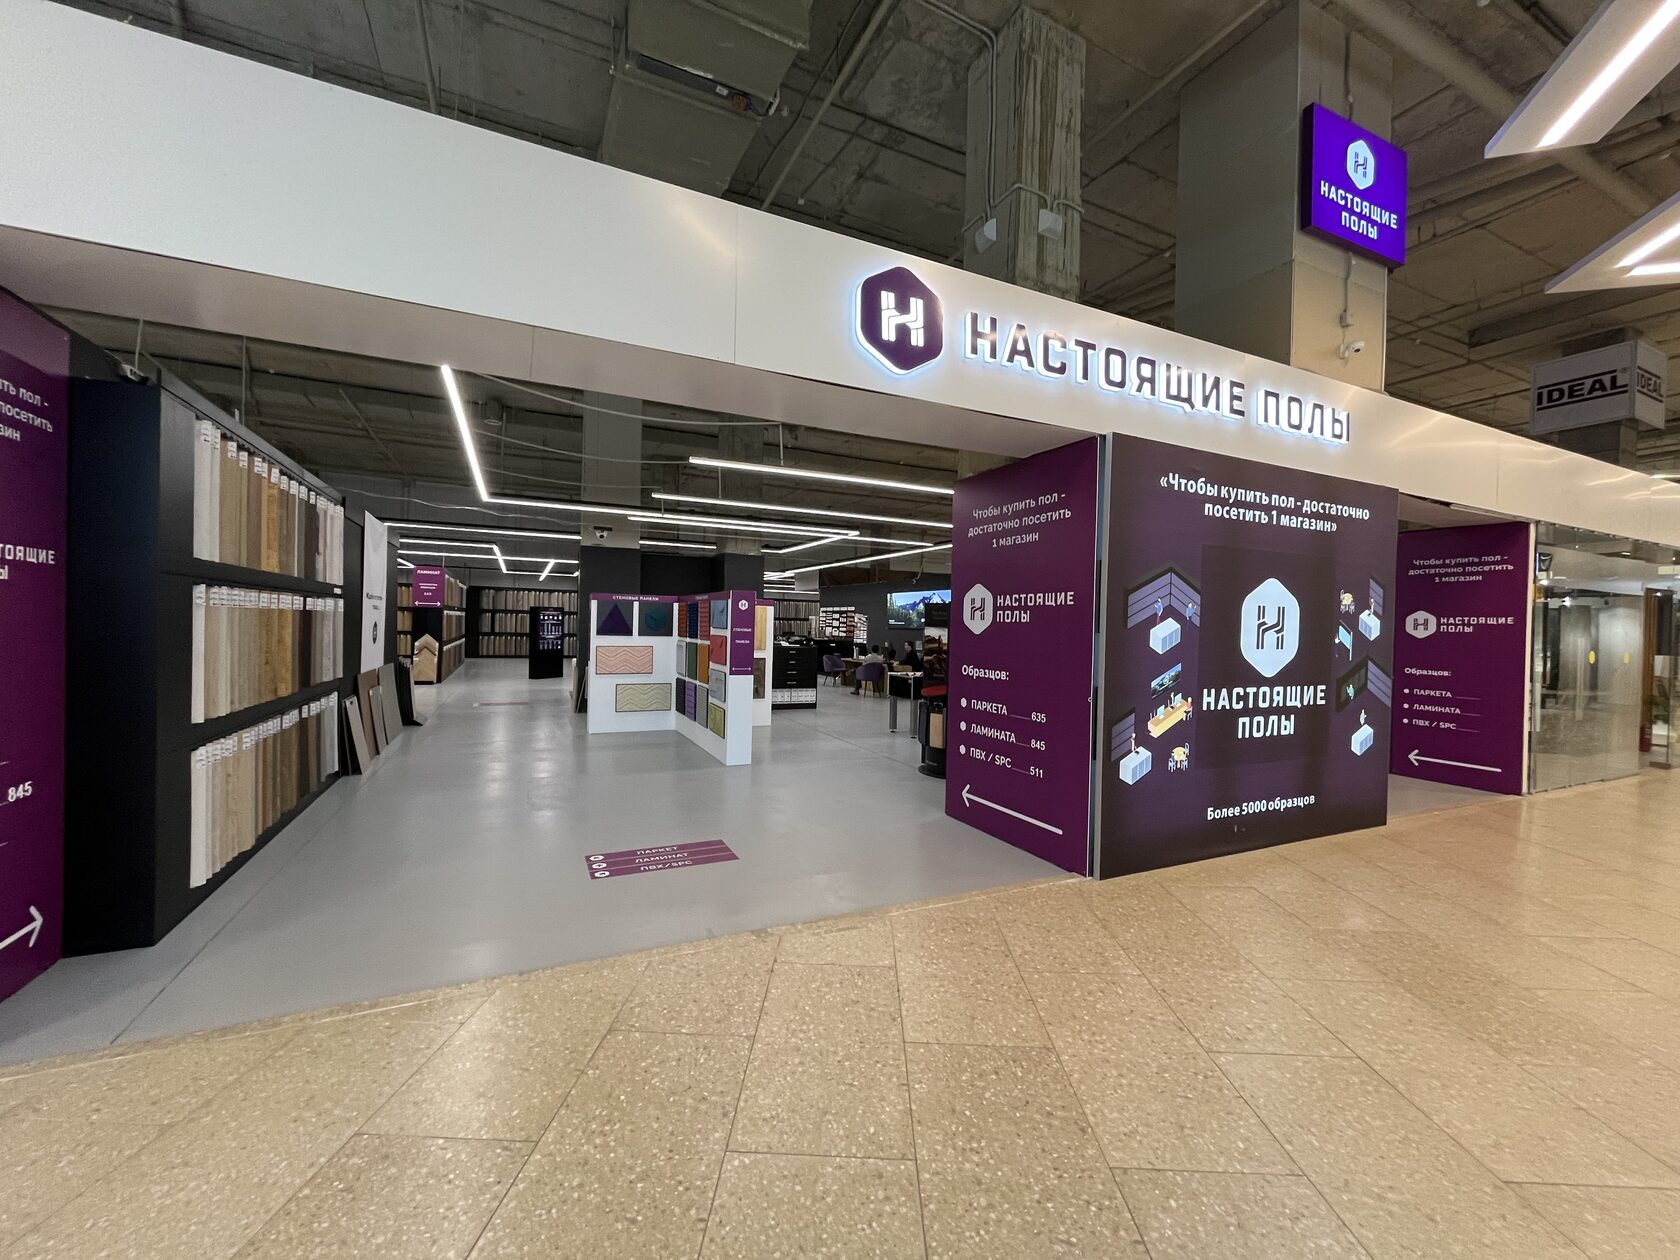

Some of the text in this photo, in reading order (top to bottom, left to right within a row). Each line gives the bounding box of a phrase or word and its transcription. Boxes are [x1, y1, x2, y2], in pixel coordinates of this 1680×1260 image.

[1320, 180, 1398, 229] НАСТОЯЩИЕ
[1341, 211, 1378, 240] ПОЛЫ
[964, 311, 1350, 444] НАСТОЯЩИЕ ПОЛЫ
[1637, 371, 1664, 398] IDEAL
[19, 387, 41, 407] пол
[1536, 374, 1629, 406] IDEAL
[972, 505, 1000, 520] Чтобы
[1002, 497, 1036, 515] купить
[1038, 492, 1058, 505] пол
[1159, 472, 1218, 497] «Чтобы
[1220, 486, 1270, 504] купить
[1272, 493, 1295, 509] пол
[1302, 499, 1370, 520] достаточно
[968, 509, 1072, 538] достаточно посетить
[1204, 502, 1337, 533] посетить 1 магазин»
[992, 532, 1039, 548] 1 магазин
[1408, 564, 1514, 575] достаточно посетить
[1413, 557, 1443, 566] Чтобы
[1445, 556, 1479, 566] купить
[1442, 574, 1482, 582] магазин
[996, 591, 1075, 607] НАСТОЯЩИЕ
[996, 610, 1030, 623] ПОЛЫ
[1440, 616, 1515, 626] НАСТОЯЩИЕ
[1440, 625, 1473, 633] ПОЛЫ
[961, 664, 1009, 681] Образцов:
[1404, 667, 1452, 677] Образцов:
[1202, 684, 1327, 711] НАСТОЯЩИЕ
[1413, 688, 1452, 698] ПАРКЕТА
[971, 699, 1047, 723] ПАРКЕТА 635
[1412, 703, 1461, 714] ЛАМИНАТА
[1237, 714, 1295, 739] ПОЛЫ
[1412, 718, 1430, 727] ПВХ
[1439, 721, 1457, 730] SPC
[970, 723, 1046, 751] ЛАМИНАТА 845
[970, 747, 986, 761] ПВХ
[994, 755, 1012, 769] SPC
[1029, 766, 1043, 778] 511
[8, 780, 33, 802] 845
[1207, 795, 1315, 820] Более 5000 образцов
[635, 852, 689, 864] ЛАМИНАТ
[636, 846, 679, 855] ПАРКЕТ
[640, 860, 693, 871] ПВХ/SPC
